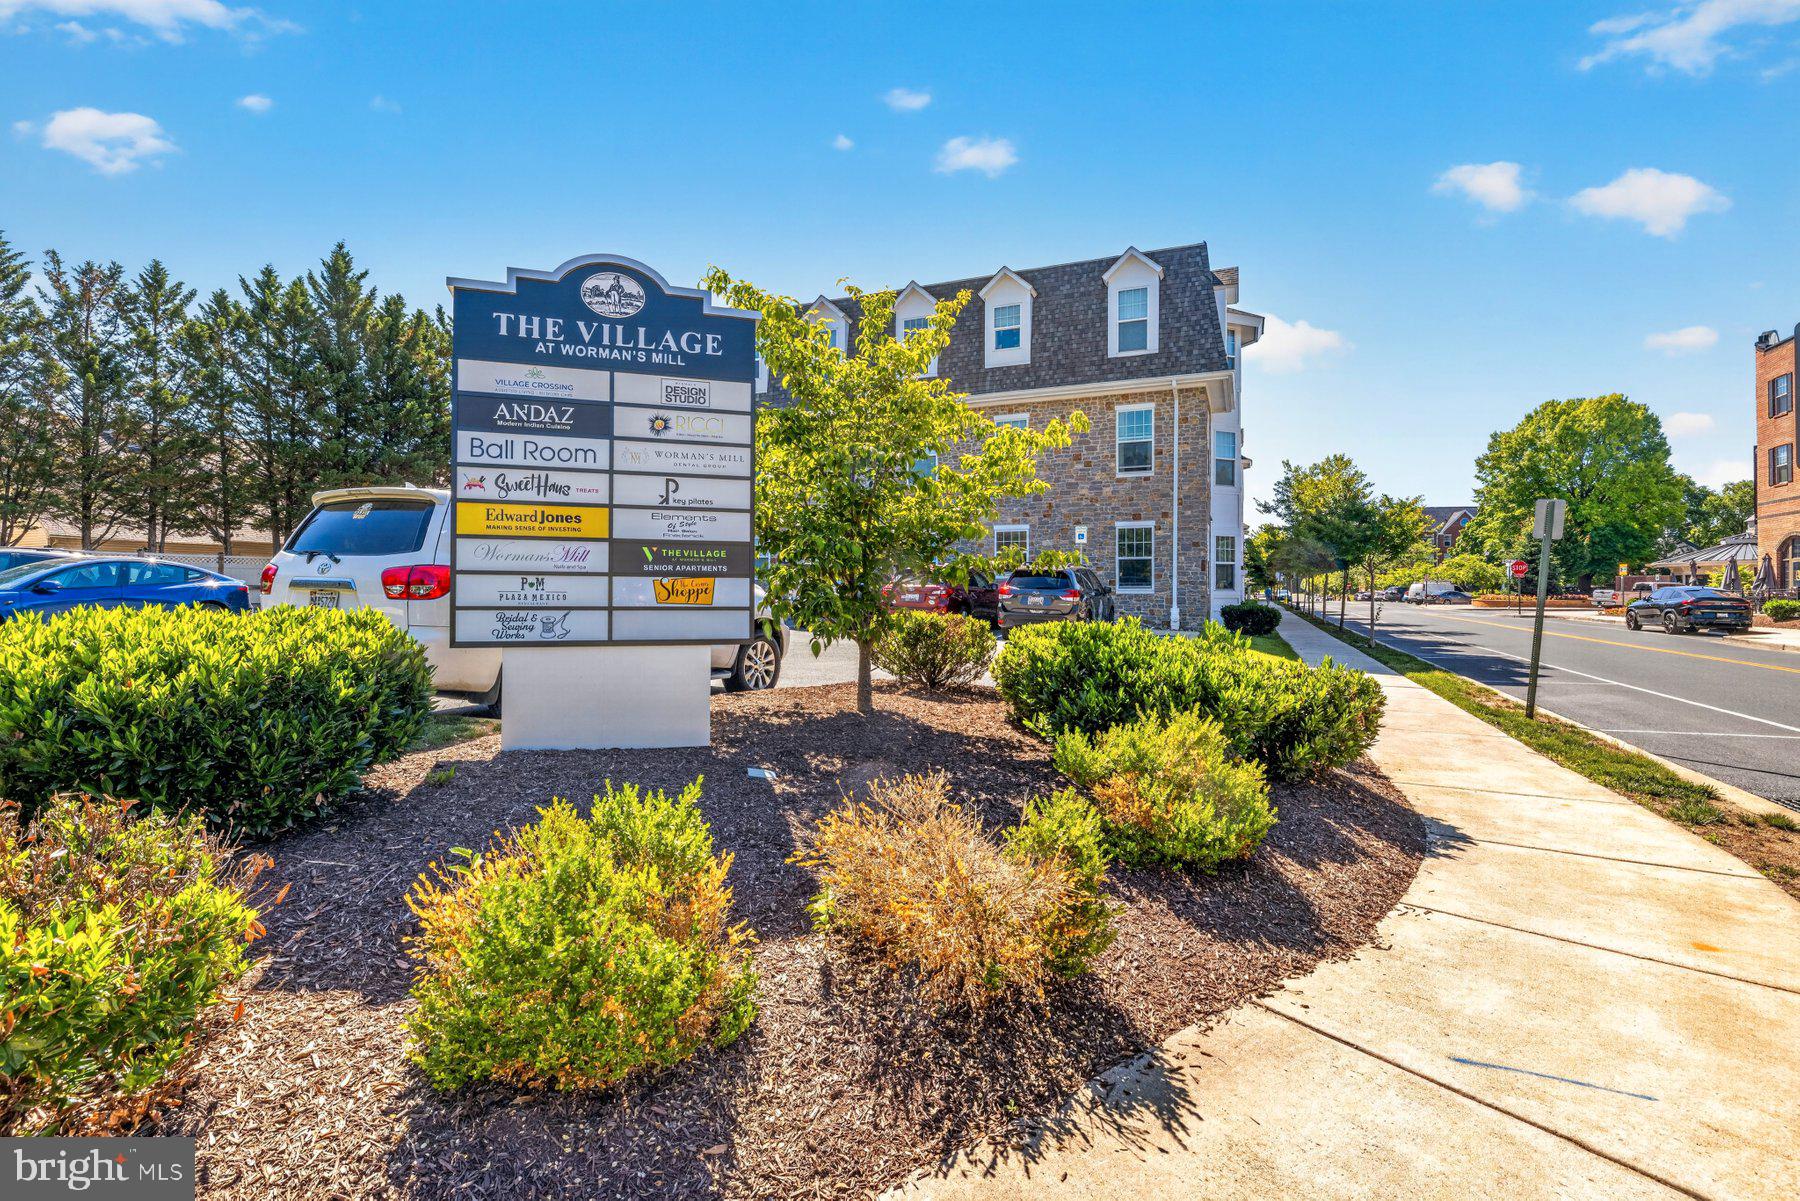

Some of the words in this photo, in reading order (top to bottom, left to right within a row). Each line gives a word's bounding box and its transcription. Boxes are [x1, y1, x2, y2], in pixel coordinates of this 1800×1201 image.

[492, 312, 565, 341] THE
[576, 321, 724, 356] VILLAGE
[535, 342, 555, 353] AT
[560, 344, 647, 363] WORMAN'S
[651, 352, 686, 366] MILL
[495, 379, 530, 388] VILLAGE
[532, 382, 574, 391] CROSSING
[665, 386, 707, 397] DESIGN
[665, 394, 707, 405] STUDIO
[493, 403, 575, 424] ANDAZ
[675, 415, 725, 433] RICCI
[470, 437, 514, 460] Ball
[523, 440, 597, 463] Room
[654, 450, 715, 461] WORMAN'S
[718, 454, 745, 463] MILL
[486, 508, 537, 522] Edward
[540, 510, 582, 524] Jones
[651, 513, 717, 522] Elements
[552, 544, 591, 563] Mill
[661, 549, 682, 557] THE
[683, 549, 727, 558] VILLAGE
[658, 577, 711, 602] Shoppe
[499, 593, 528, 601] PLAZA
[531, 593, 567, 601] MEXICO
[495, 612, 529, 623] Bridal
[530, 614, 538, 622] &
[501, 622, 536, 632] Sewing
[491, 629, 526, 640] Works
